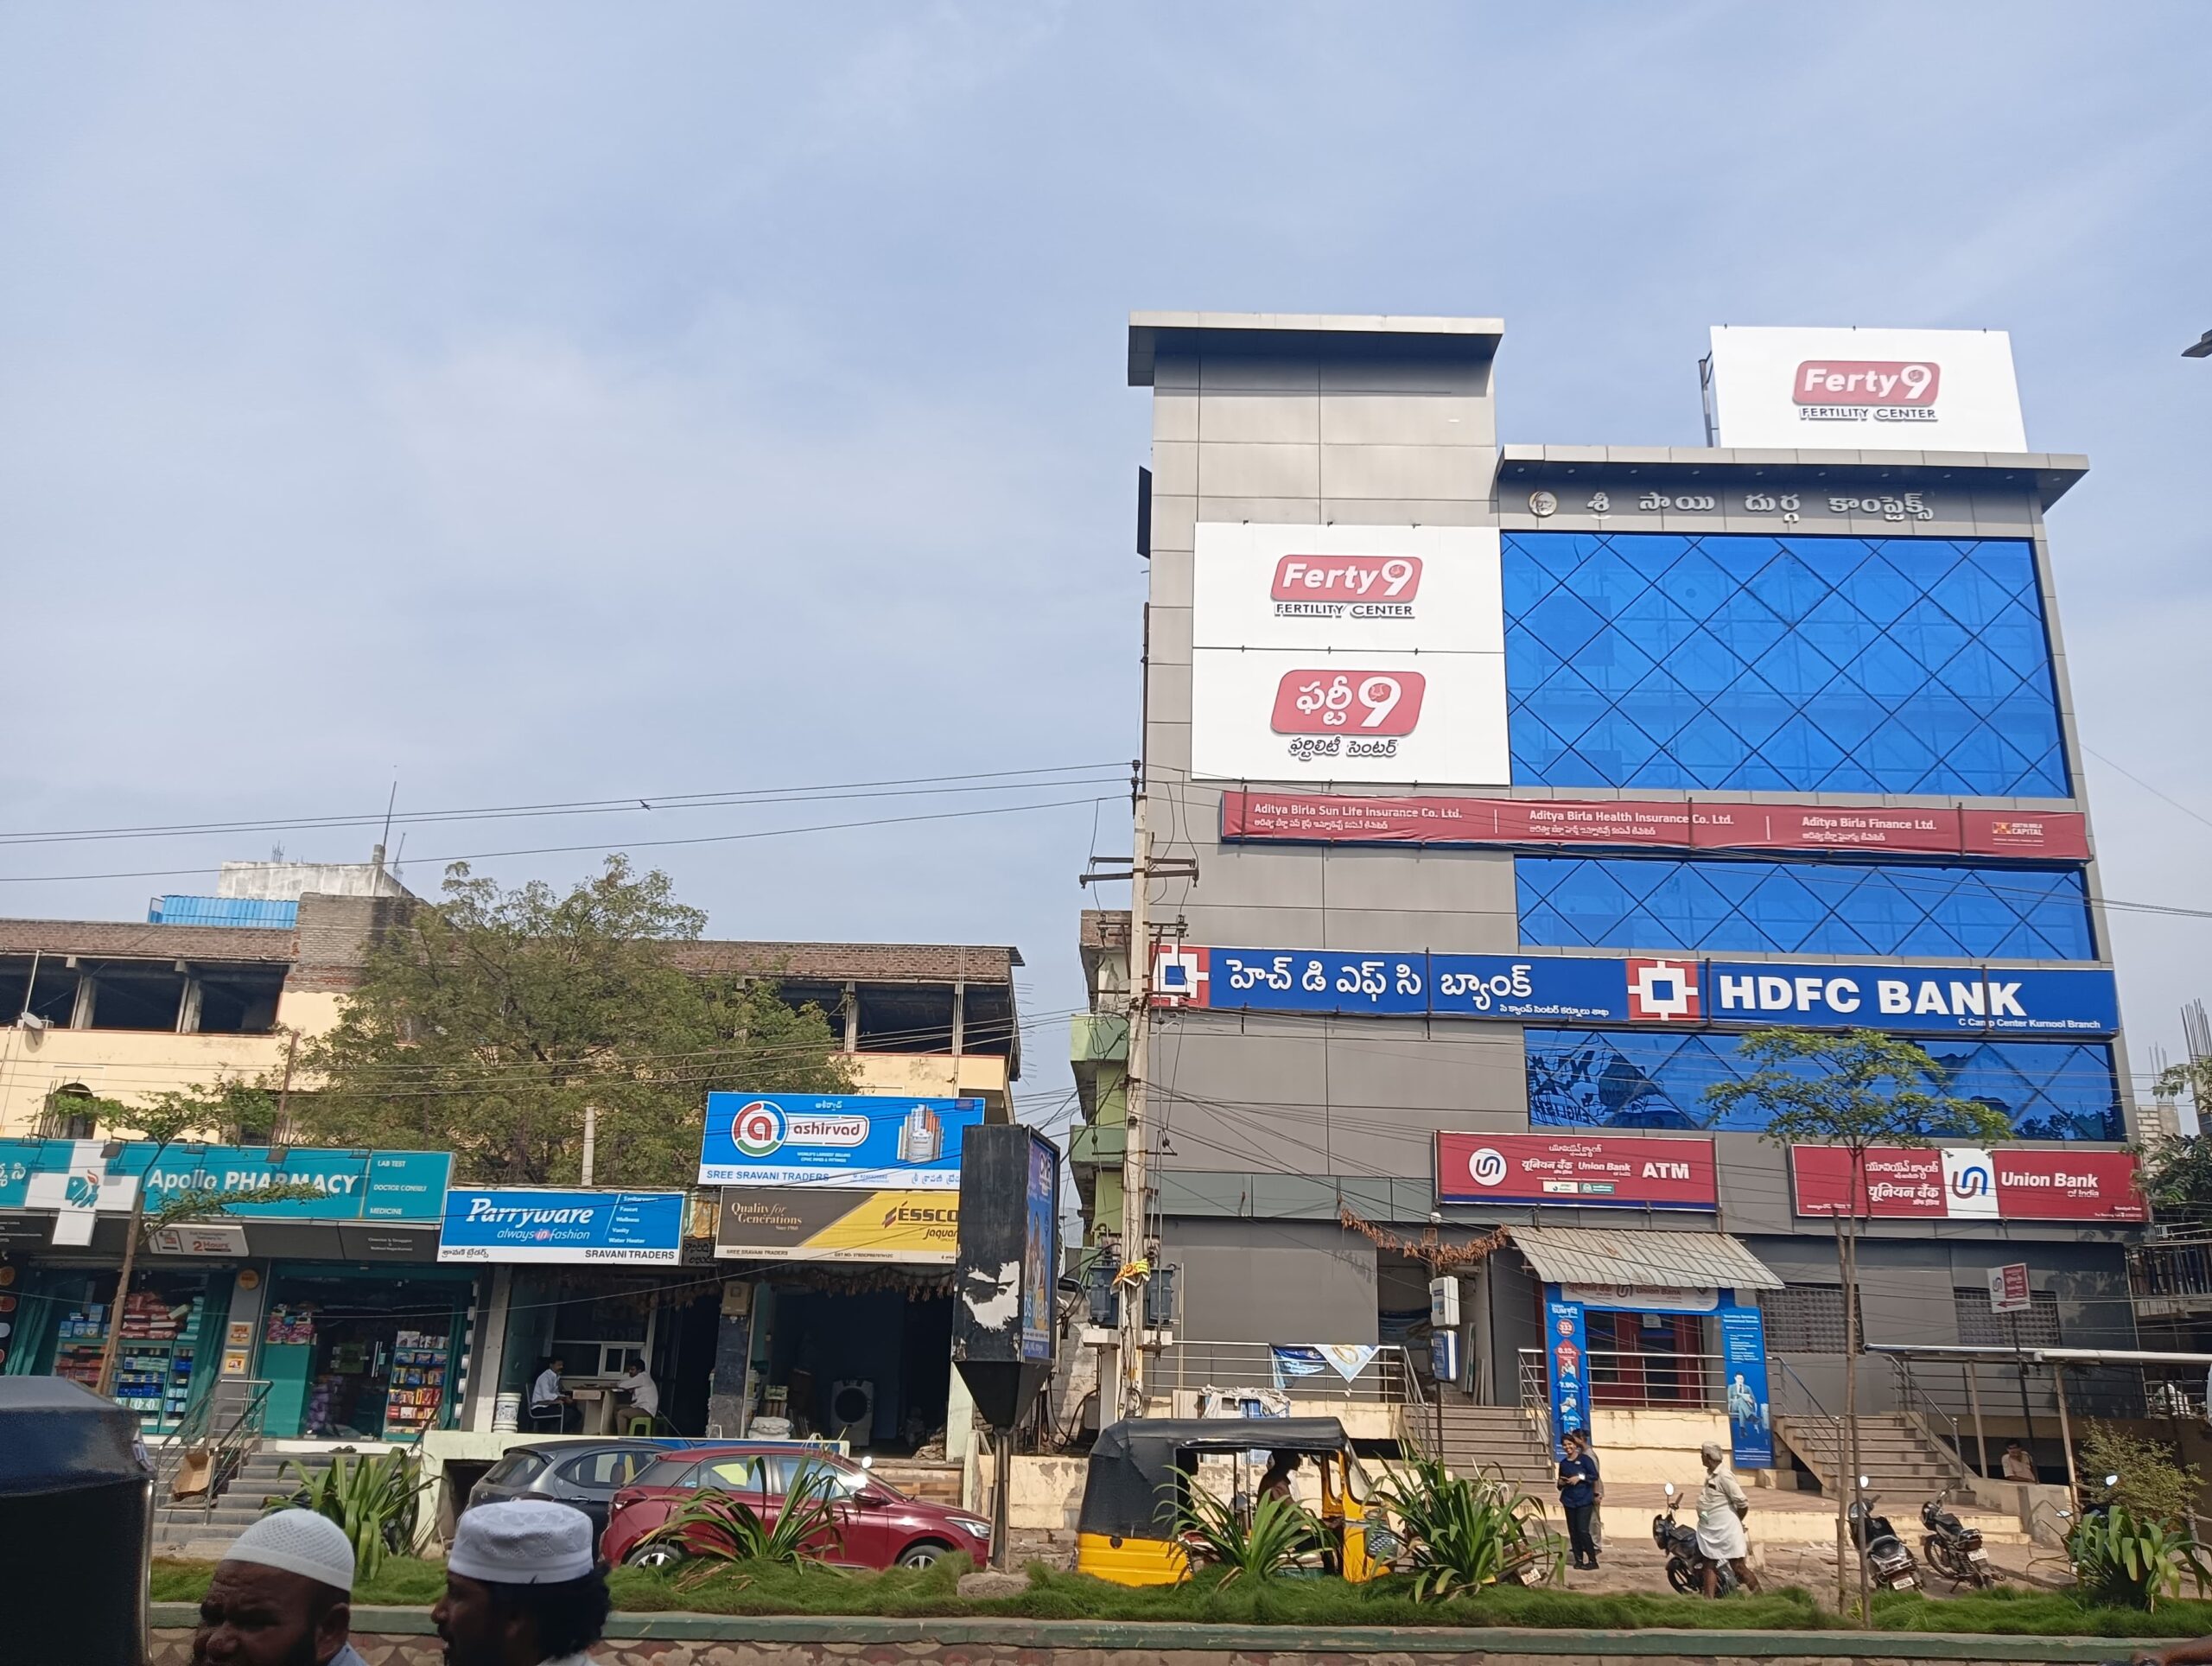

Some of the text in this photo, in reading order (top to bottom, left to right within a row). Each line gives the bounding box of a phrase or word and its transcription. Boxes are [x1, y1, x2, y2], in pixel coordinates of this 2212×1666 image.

[1803, 365, 1932, 399] Ferty9
[1802, 408, 1936, 419] FERTILITY CENTER
[1639, 492, 1715, 511] సాయి
[1745, 493, 1801, 523] దుర్గ
[1282, 559, 1414, 596] Ferty9
[1276, 603, 1413, 615] FERTILITY CENTER
[1348, 740, 1398, 755] సెంటర్
[1255, 804, 1463, 818] Aditya Birla Sun Life Insurance Co. Ltd.
[1529, 810, 1734, 824] Aditya Birla Health Insurance Co. Ltd.
[1802, 817, 1937, 830] Aditya Birla Finance Ltd.
[1301, 960, 1327, 992] డి
[1336, 961, 1387, 1002] ఎఫ్
[1395, 963, 1423, 995] సి
[1440, 964, 1533, 1011] బ్యాంక్
[1719, 975, 2028, 1017] HDFC BANK
[1997, 1019, 2027, 1027] Center
[2030, 1020, 2065, 1028] Kurnool
[2068, 1021, 2101, 1029] Branch
[793, 1122, 861, 1135] ashirvad
[1522, 1159, 1555, 1172] यूनियन
[1578, 1161, 1631, 1172] Union Bank
[1642, 1163, 1690, 1180] ATM
[148, 1169, 217, 1192] Apollo
[707, 1170, 830, 1181] SREE SRAVANI TRADERS
[2001, 1171, 2098, 1188] Union Bank
[1868, 1182, 1916, 1201] यूनियन
[466, 1198, 594, 1228] Parryware
[731, 1202, 786, 1216] Quality for
[738, 1213, 802, 1224] Generations
[497, 1228, 590, 1242] always in fashion
[193, 1241, 204, 1251] 2
[585, 1250, 674, 1259] SRAVANI TRADERS
[1636, 1285, 1682, 1295] Union Bank
